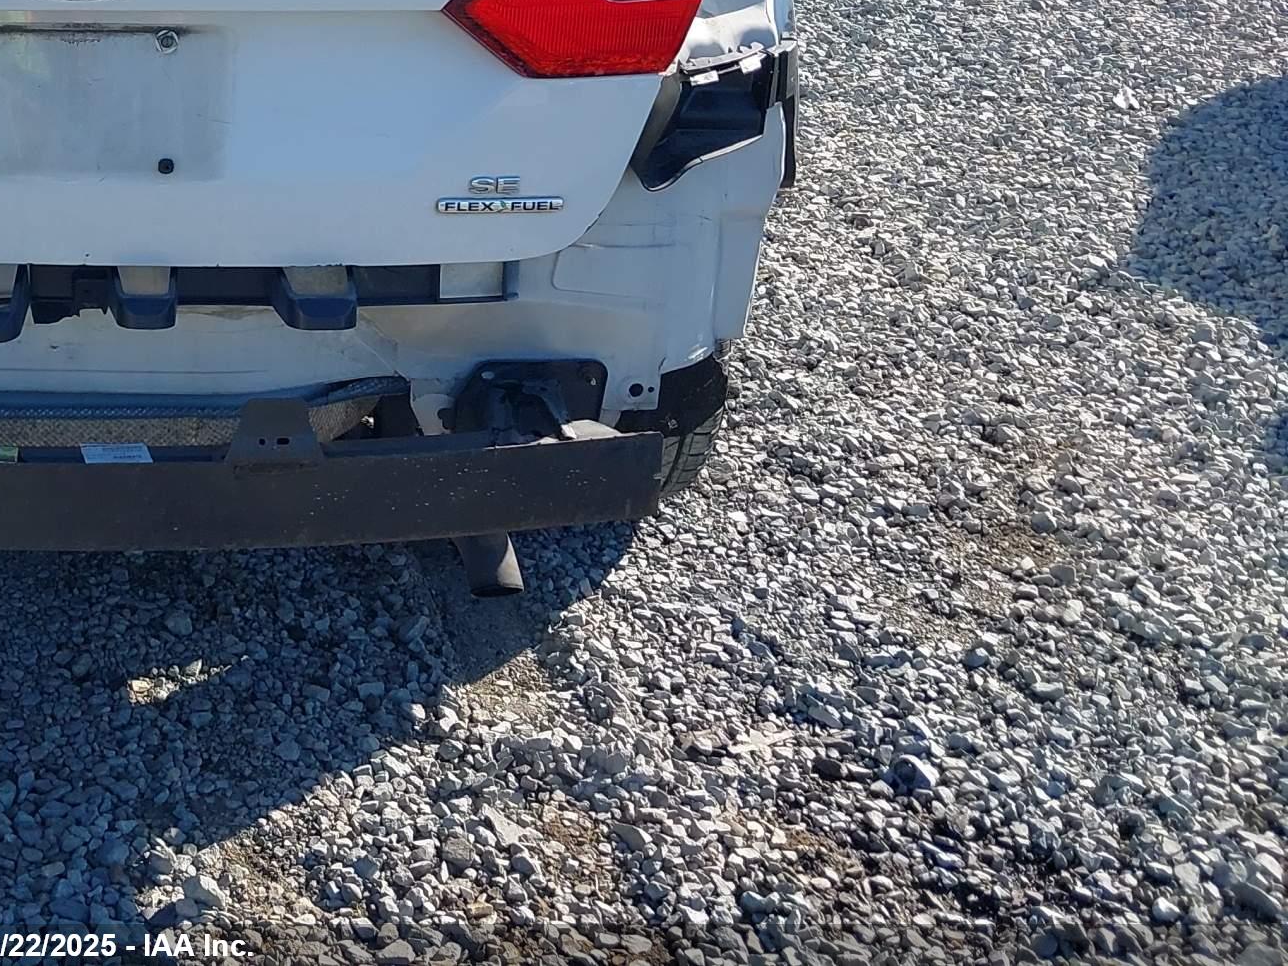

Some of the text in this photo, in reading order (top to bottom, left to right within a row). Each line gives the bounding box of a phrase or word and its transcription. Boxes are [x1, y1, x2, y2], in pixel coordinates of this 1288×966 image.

[469, 175, 521, 195] SE
[444, 201, 560, 212] FLEX FUEL
